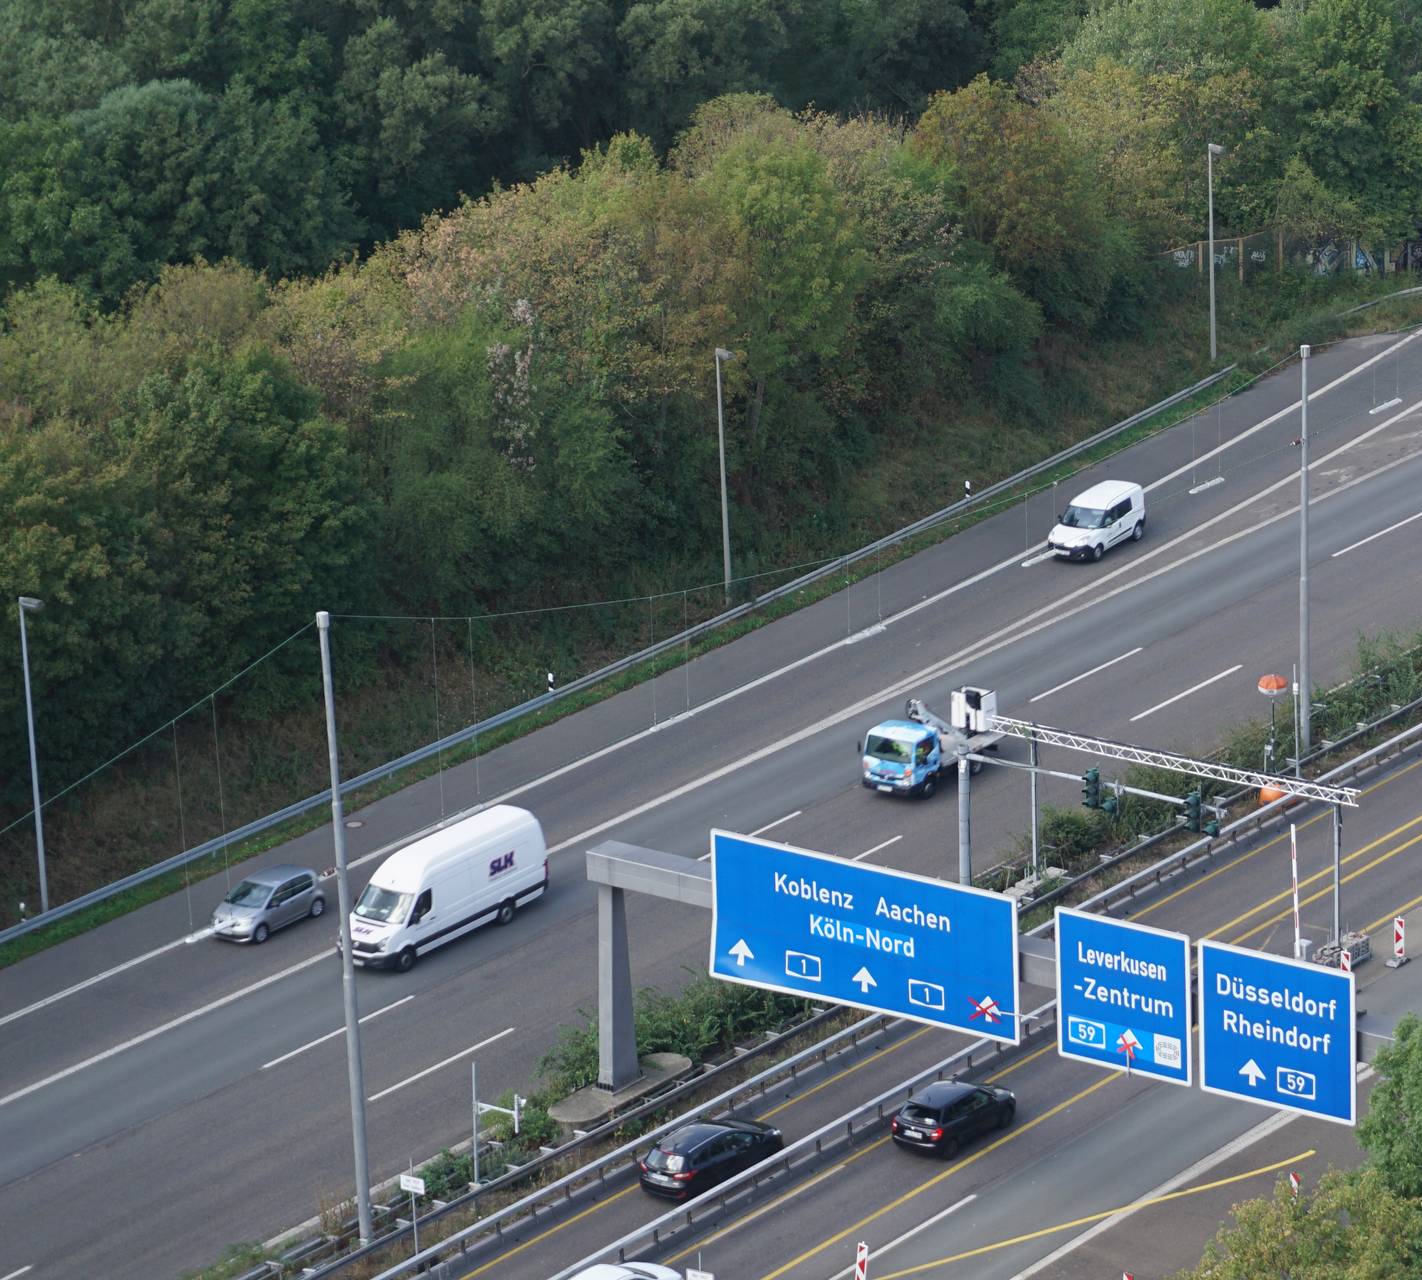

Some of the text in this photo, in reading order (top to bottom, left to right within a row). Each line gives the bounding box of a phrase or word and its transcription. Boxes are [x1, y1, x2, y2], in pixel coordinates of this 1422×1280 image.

[489, 850, 515, 877] SLK
[774, 871, 951, 932] Koblenz Aachen
[809, 913, 915, 958] Köln-Nord
[800, 958, 806, 975] 1
[1077, 940, 1167, 982] Leverkusen
[923, 986, 930, 1003] 1
[1073, 976, 1174, 1019] -Zentrum
[1216, 972, 1336, 1020] Düsseldorf
[1078, 1022, 1096, 1041] 59
[1223, 1009, 1331, 1055] Rheindorf
[1286, 1073, 1306, 1092] 59
